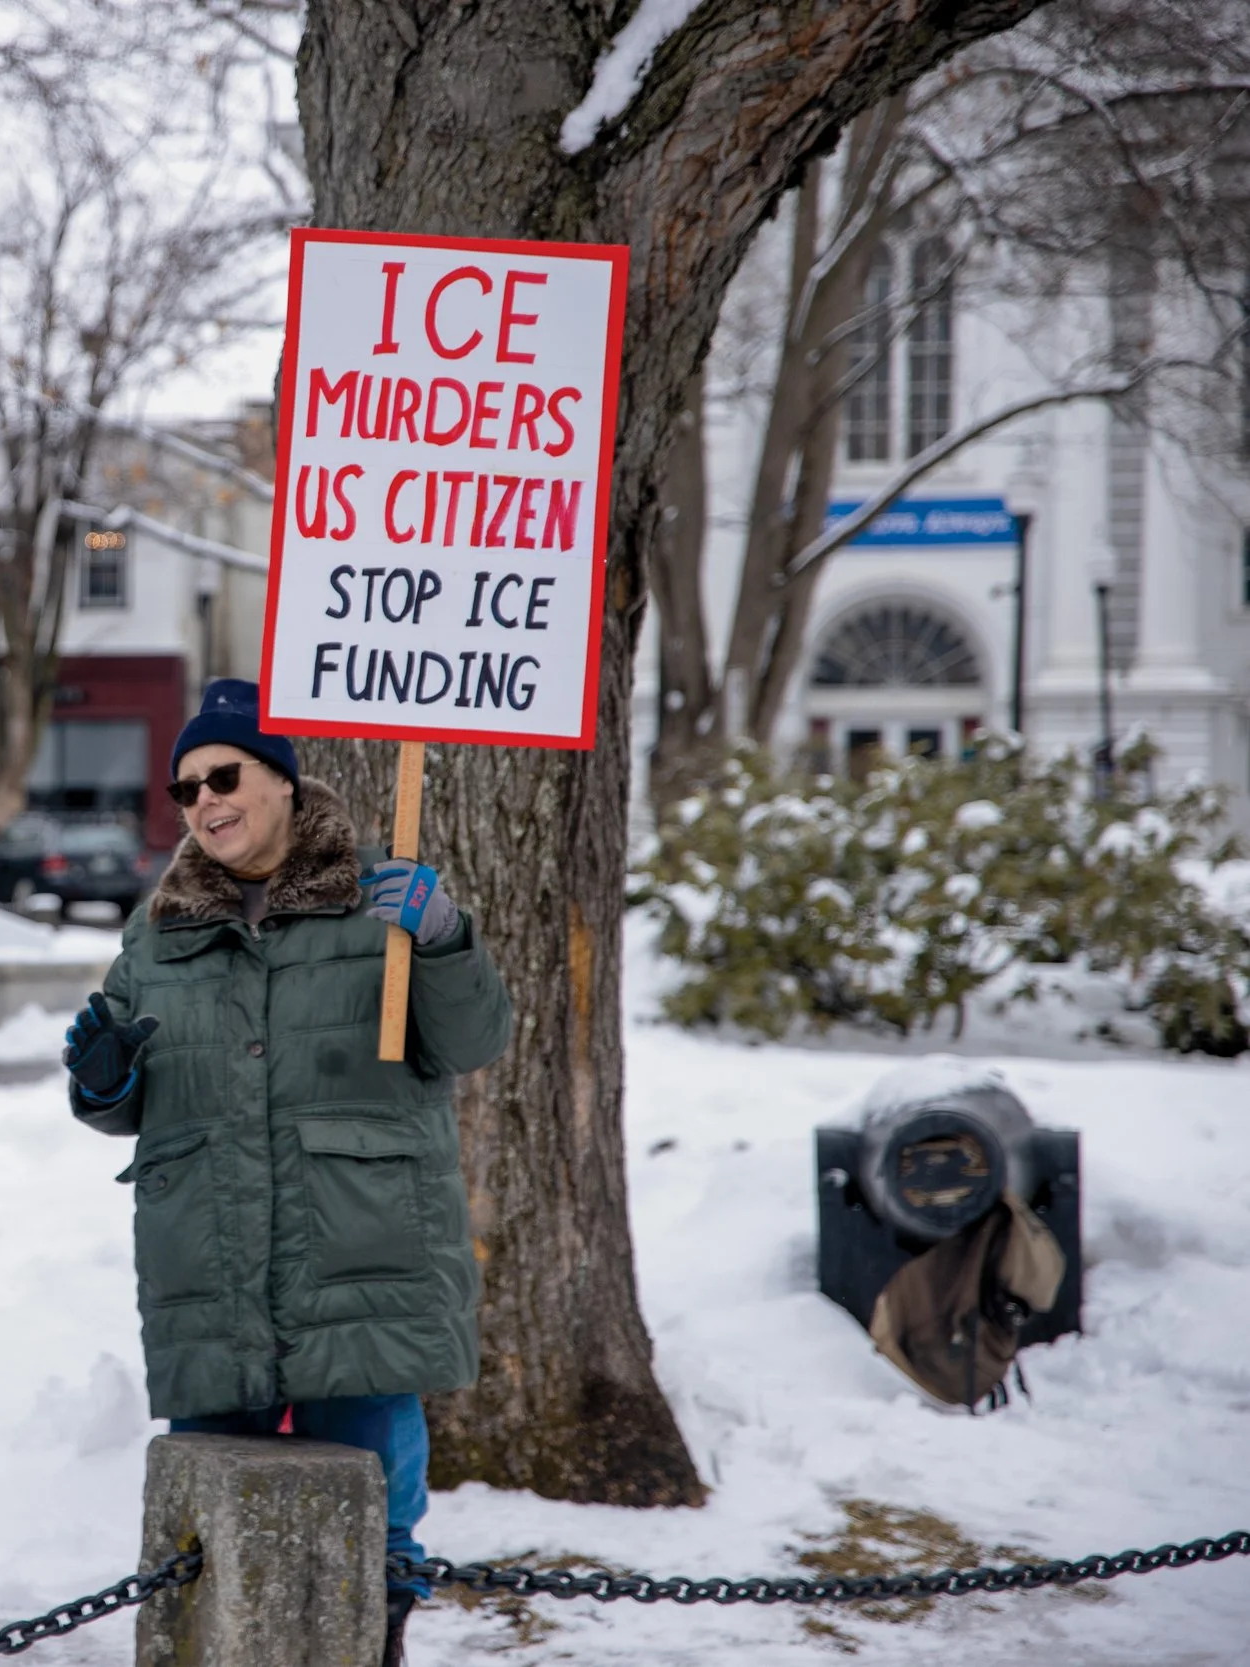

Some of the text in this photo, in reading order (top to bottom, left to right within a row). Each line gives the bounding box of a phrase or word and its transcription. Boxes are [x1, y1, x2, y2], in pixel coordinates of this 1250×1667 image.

[372, 261, 549, 365] ICE
[305, 367, 583, 458] MURDERS
[295, 463, 585, 553] US CITIZEN
[325, 564, 556, 630] STOP ICE
[311, 642, 541, 711] FUNDING
